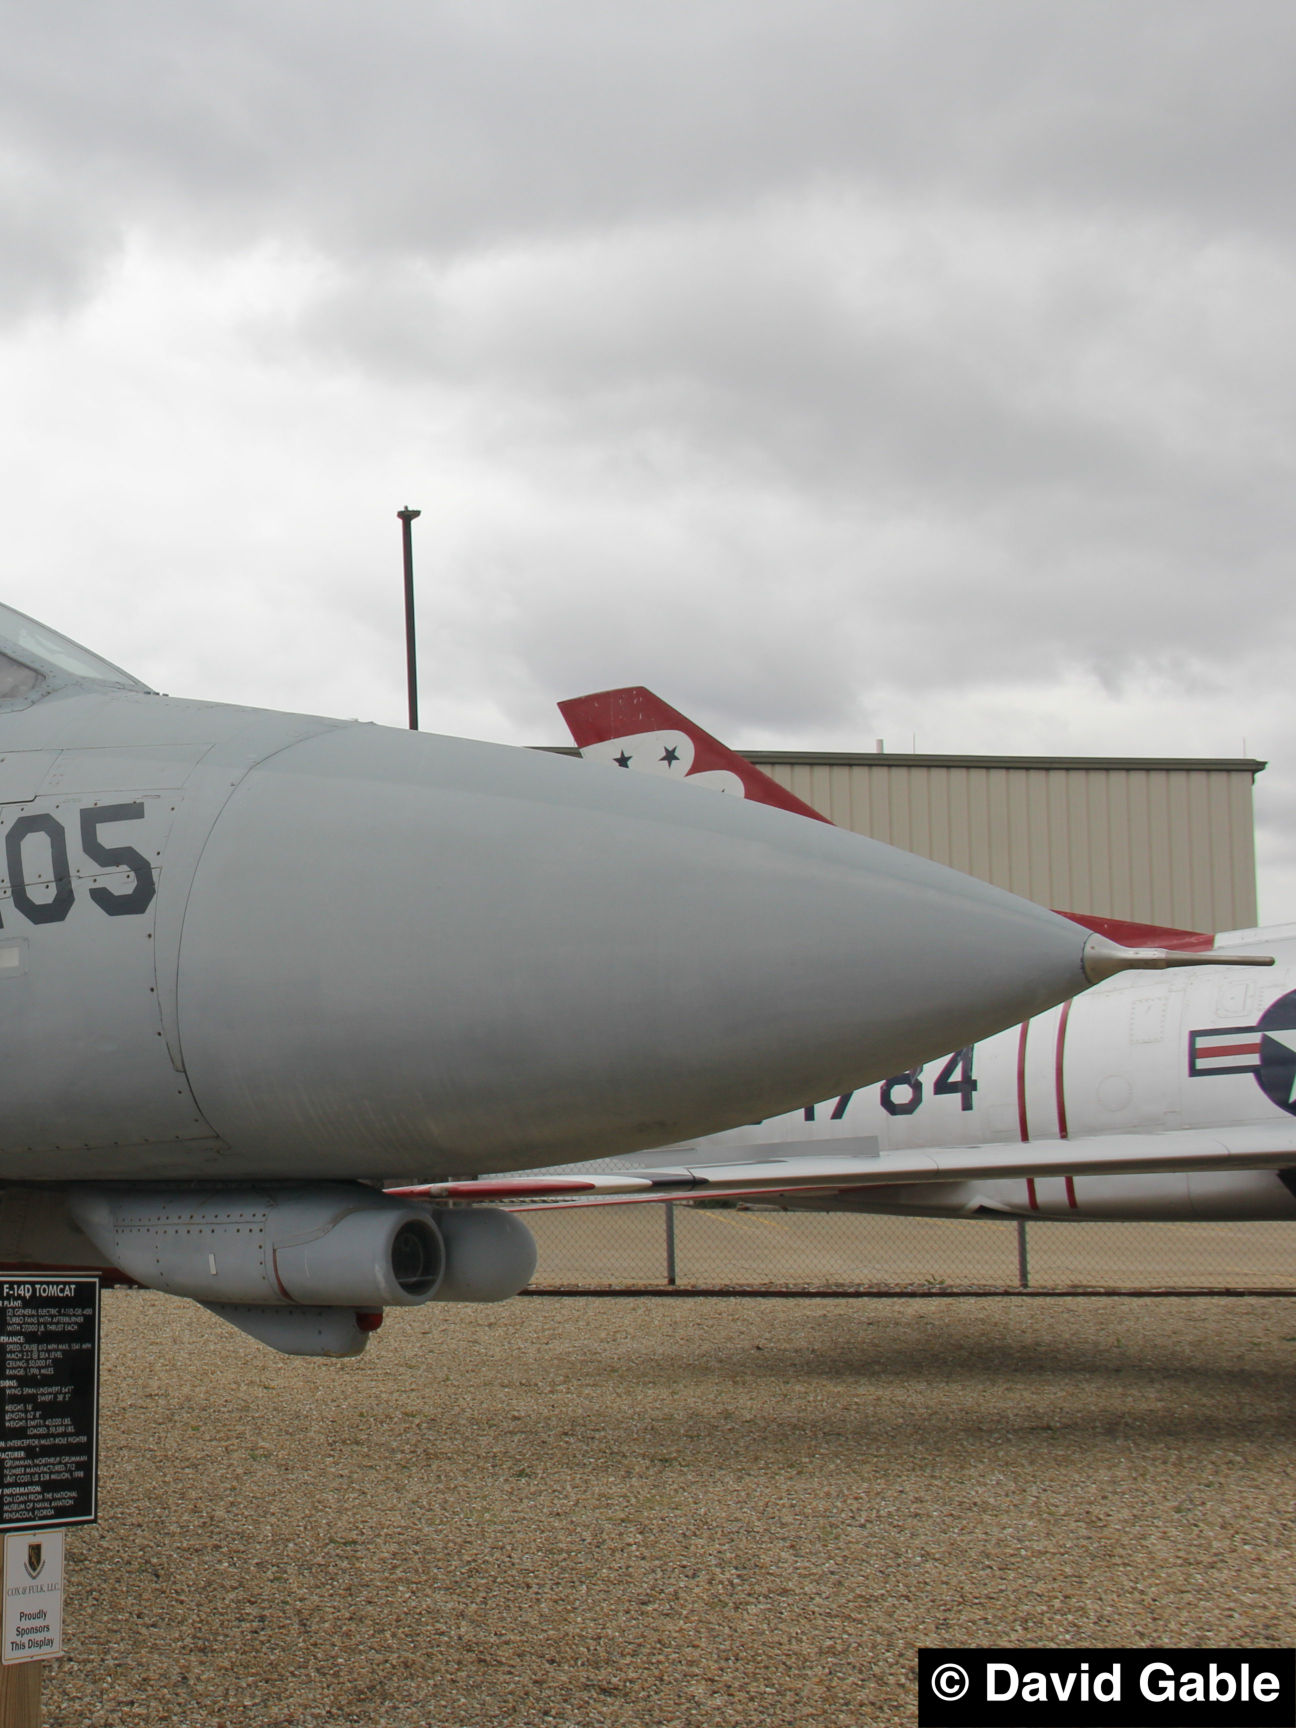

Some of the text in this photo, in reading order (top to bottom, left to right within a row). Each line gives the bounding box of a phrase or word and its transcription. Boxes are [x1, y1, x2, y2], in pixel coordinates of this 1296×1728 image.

[4, 1285, 76, 1297] F-14D TOMCAT
[41, 1437, 67, 1445] MULTI-ROLE
[8, 1587, 20, 1597] COX
[20, 1609, 47, 1622] Proudly
[16, 1624, 50, 1638] Sponsors
[11, 1638, 54, 1652] This Display
